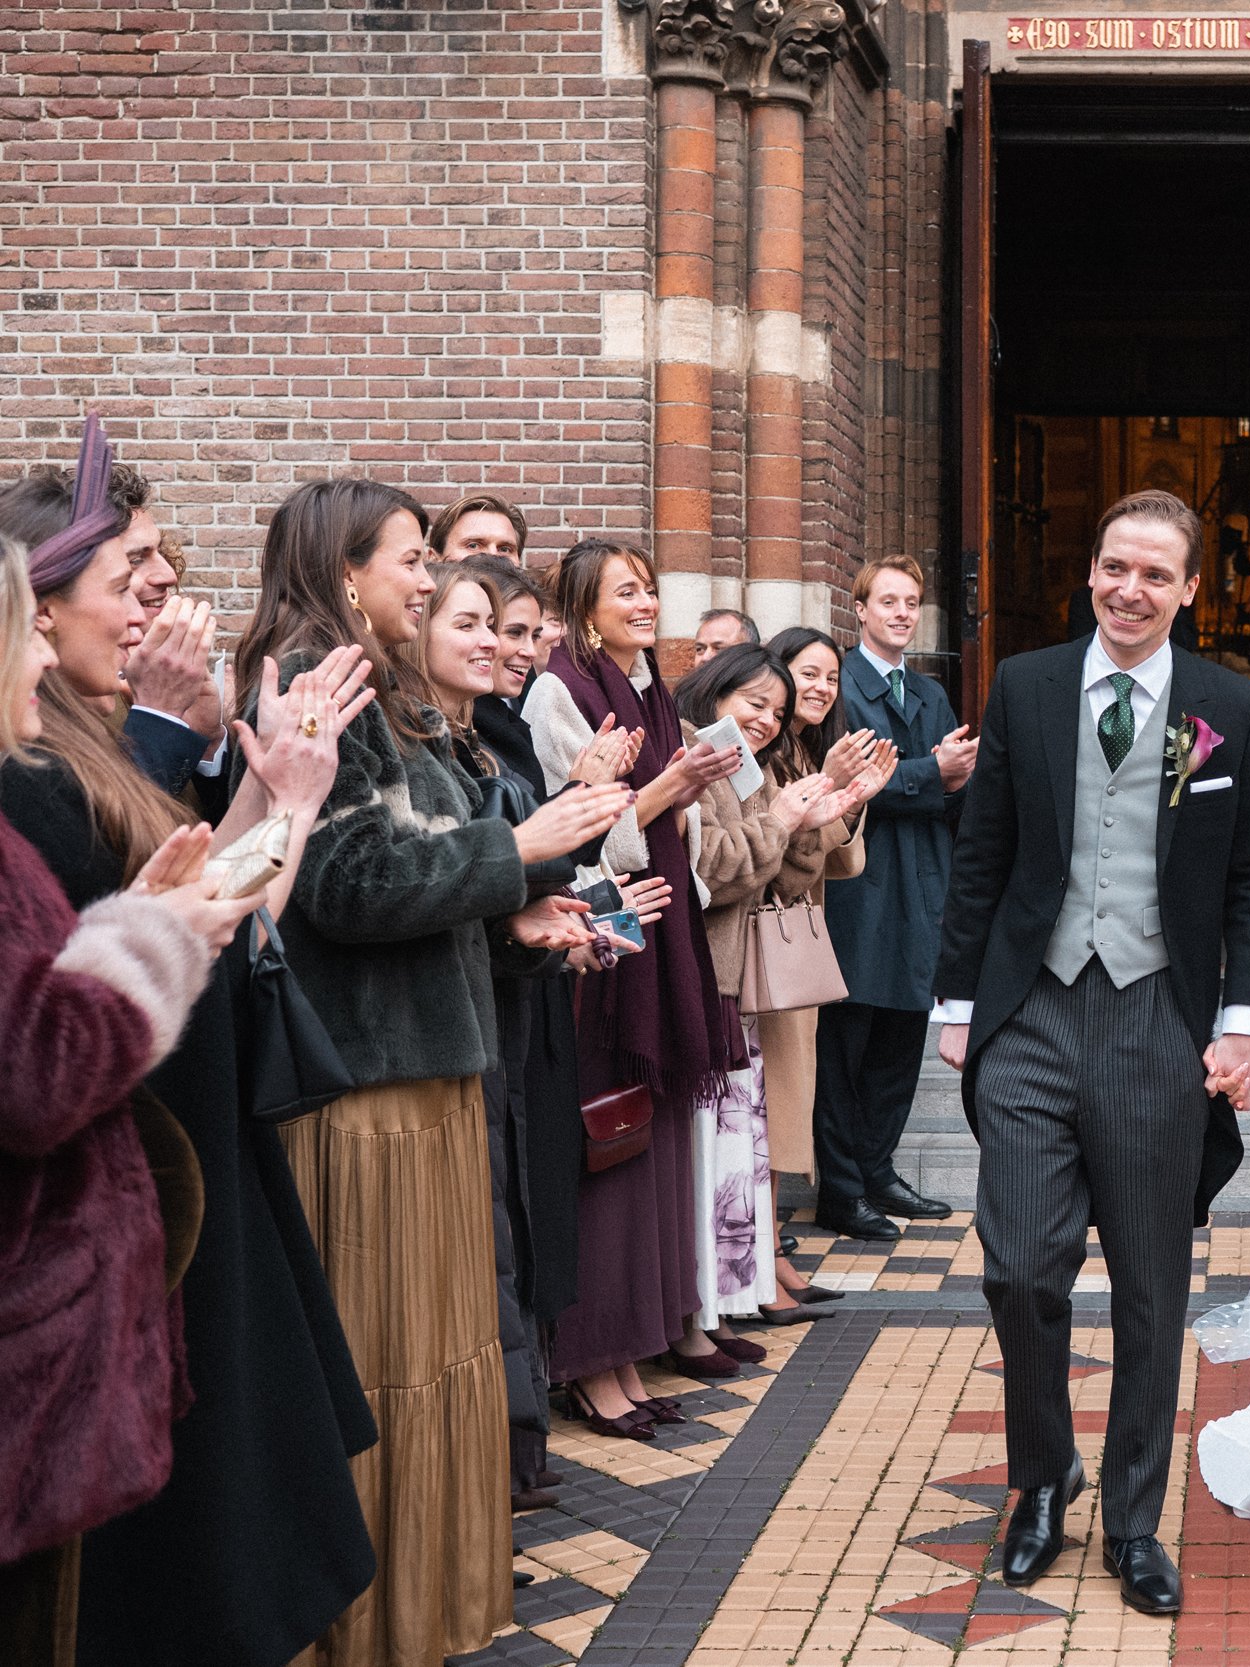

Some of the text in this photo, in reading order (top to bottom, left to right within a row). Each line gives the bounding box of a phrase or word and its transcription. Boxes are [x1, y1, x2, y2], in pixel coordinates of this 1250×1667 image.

[1026, 18, 1070, 50] Ego
[1085, 19, 1134, 49] sum
[1152, 18, 1240, 49] ostium
